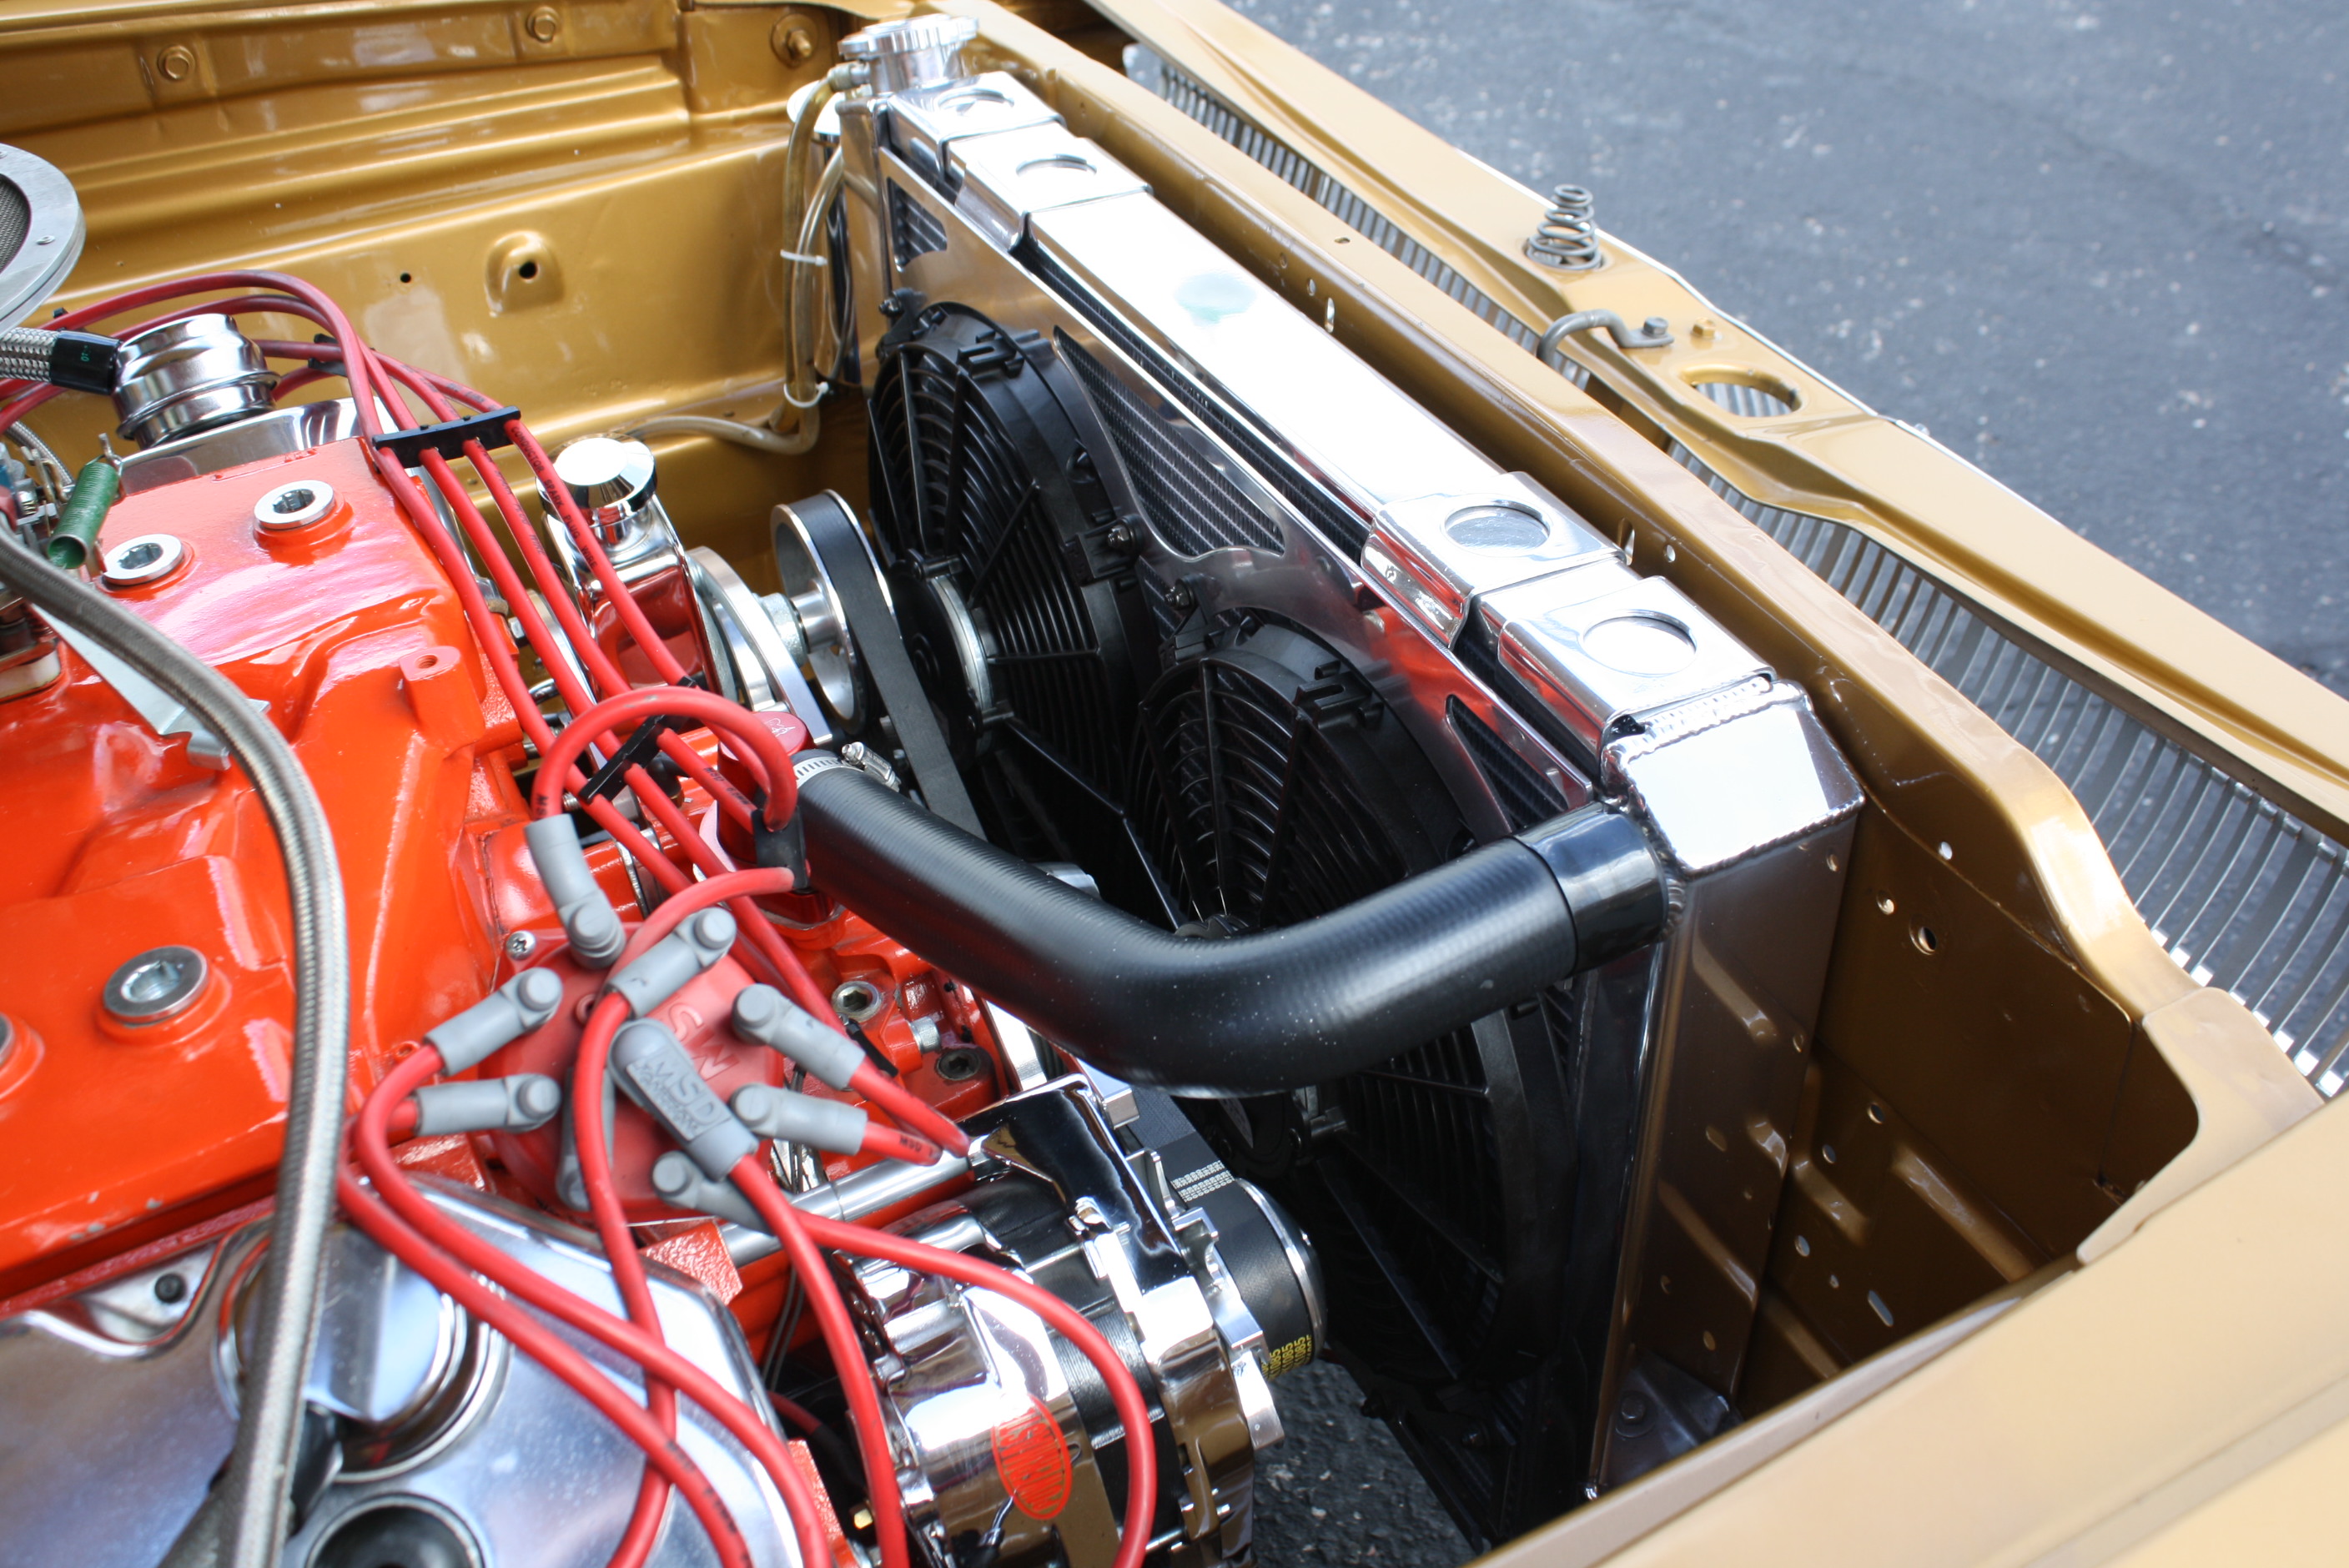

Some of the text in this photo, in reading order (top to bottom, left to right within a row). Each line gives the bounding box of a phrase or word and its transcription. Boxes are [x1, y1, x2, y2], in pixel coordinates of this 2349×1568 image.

[511, 426, 598, 569] CONDUCTOR SPARK PLUG WIRE
[646, 1046, 723, 1124] MSD
